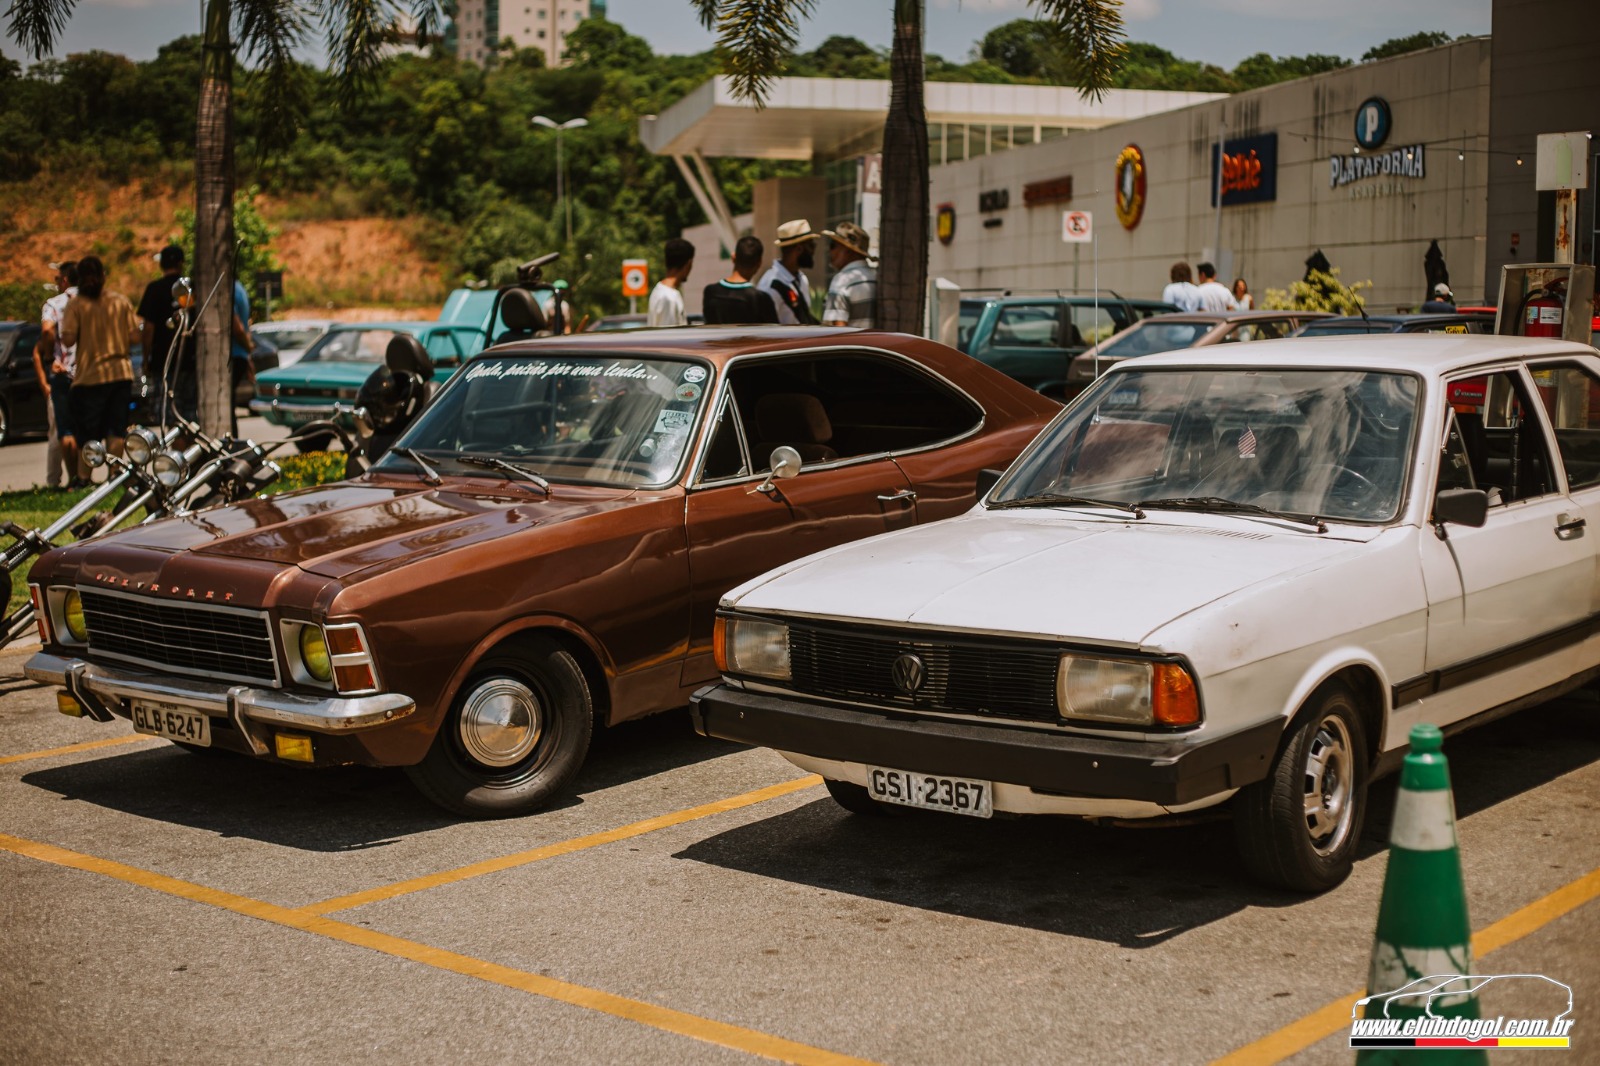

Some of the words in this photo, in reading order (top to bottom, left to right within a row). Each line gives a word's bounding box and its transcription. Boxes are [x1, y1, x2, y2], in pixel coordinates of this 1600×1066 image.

[1365, 106, 1379, 142] P
[1329, 144, 1424, 189] PLATAFORMA
[498, 362, 548, 380] paixão
[540, 363, 572, 379] por
[570, 364, 604, 376] uma
[603, 362, 658, 379] lenda...
[96, 573, 234, 601] CHEVROLET
